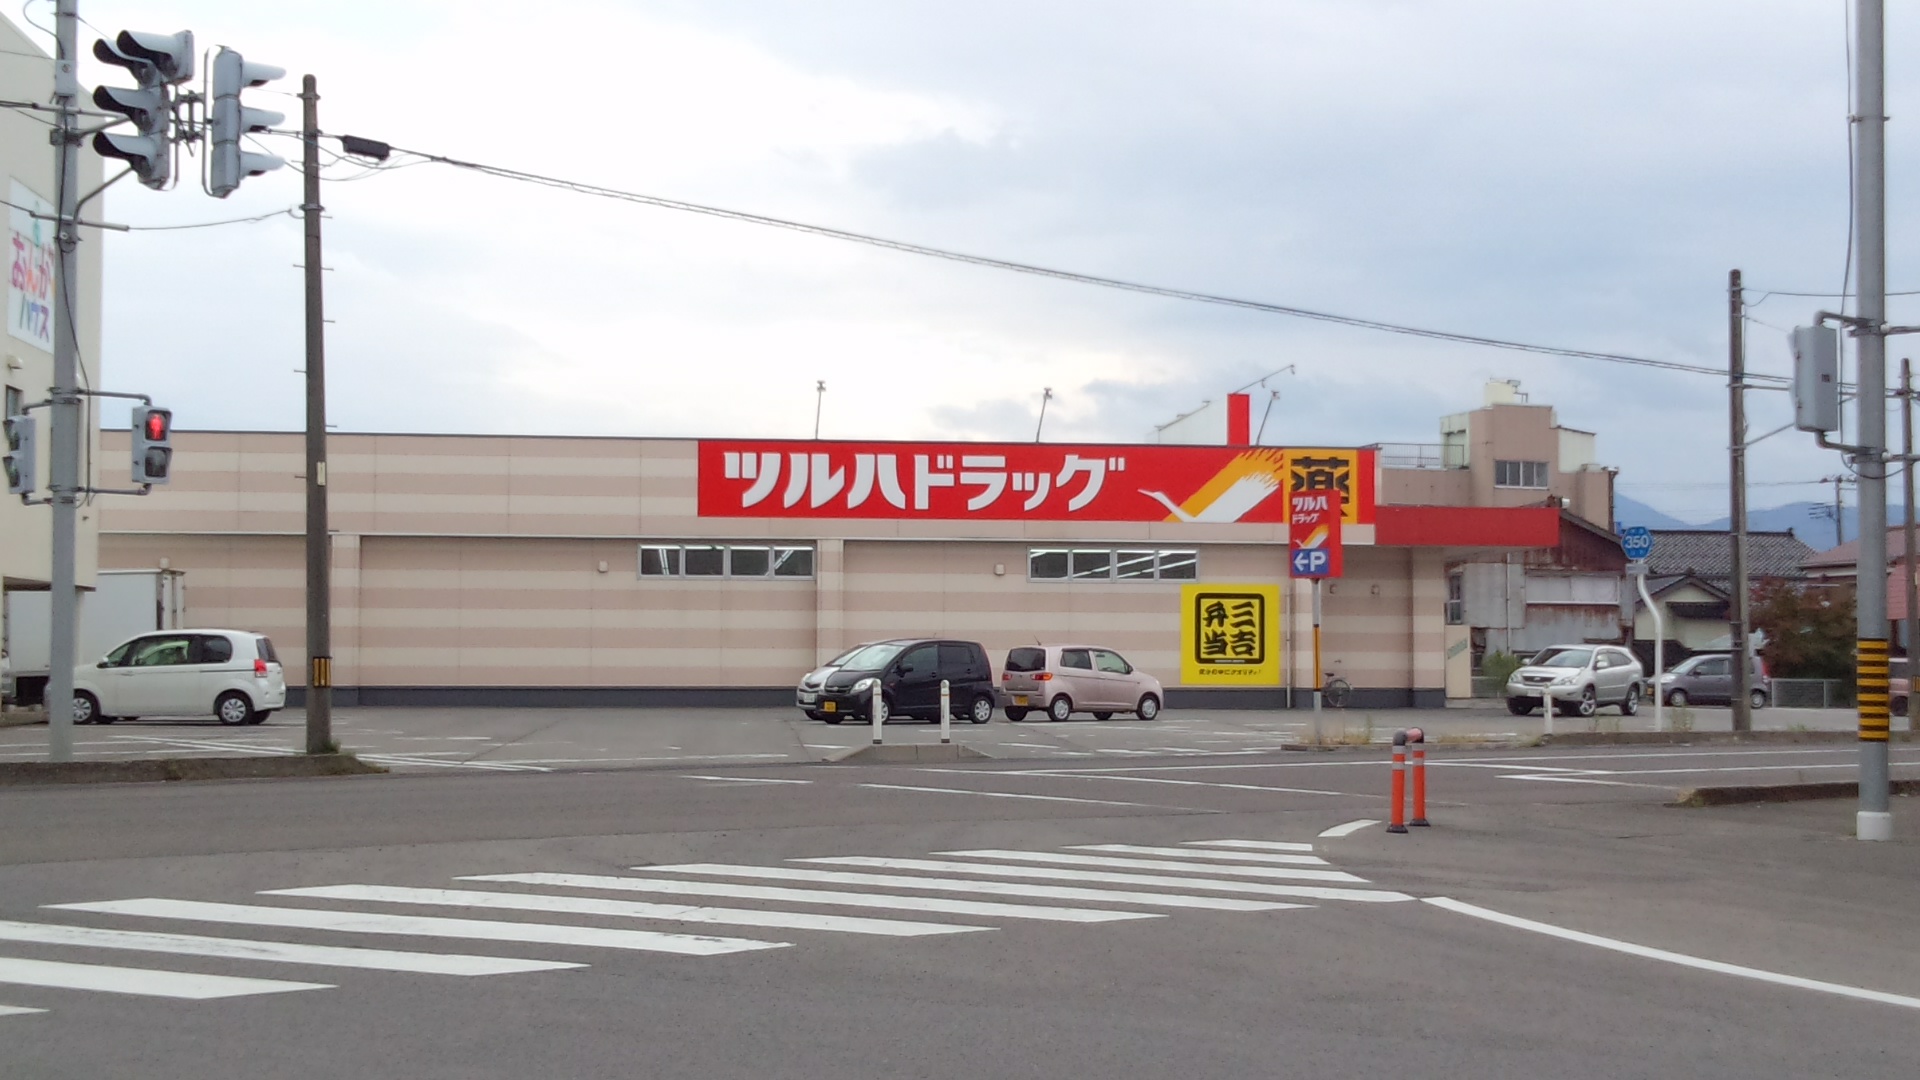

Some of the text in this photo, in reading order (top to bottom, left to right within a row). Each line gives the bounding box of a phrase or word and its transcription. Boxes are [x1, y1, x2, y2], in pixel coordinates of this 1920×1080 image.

[723, 452, 1126, 512] ツルハドラッグ
[1292, 496, 1328, 512] ツルハ
[1625, 535, 1649, 548] 350
[1310, 551, 1326, 571] P
[1202, 601, 1229, 656] 弁当
[1230, 601, 1256, 656] 三吉
